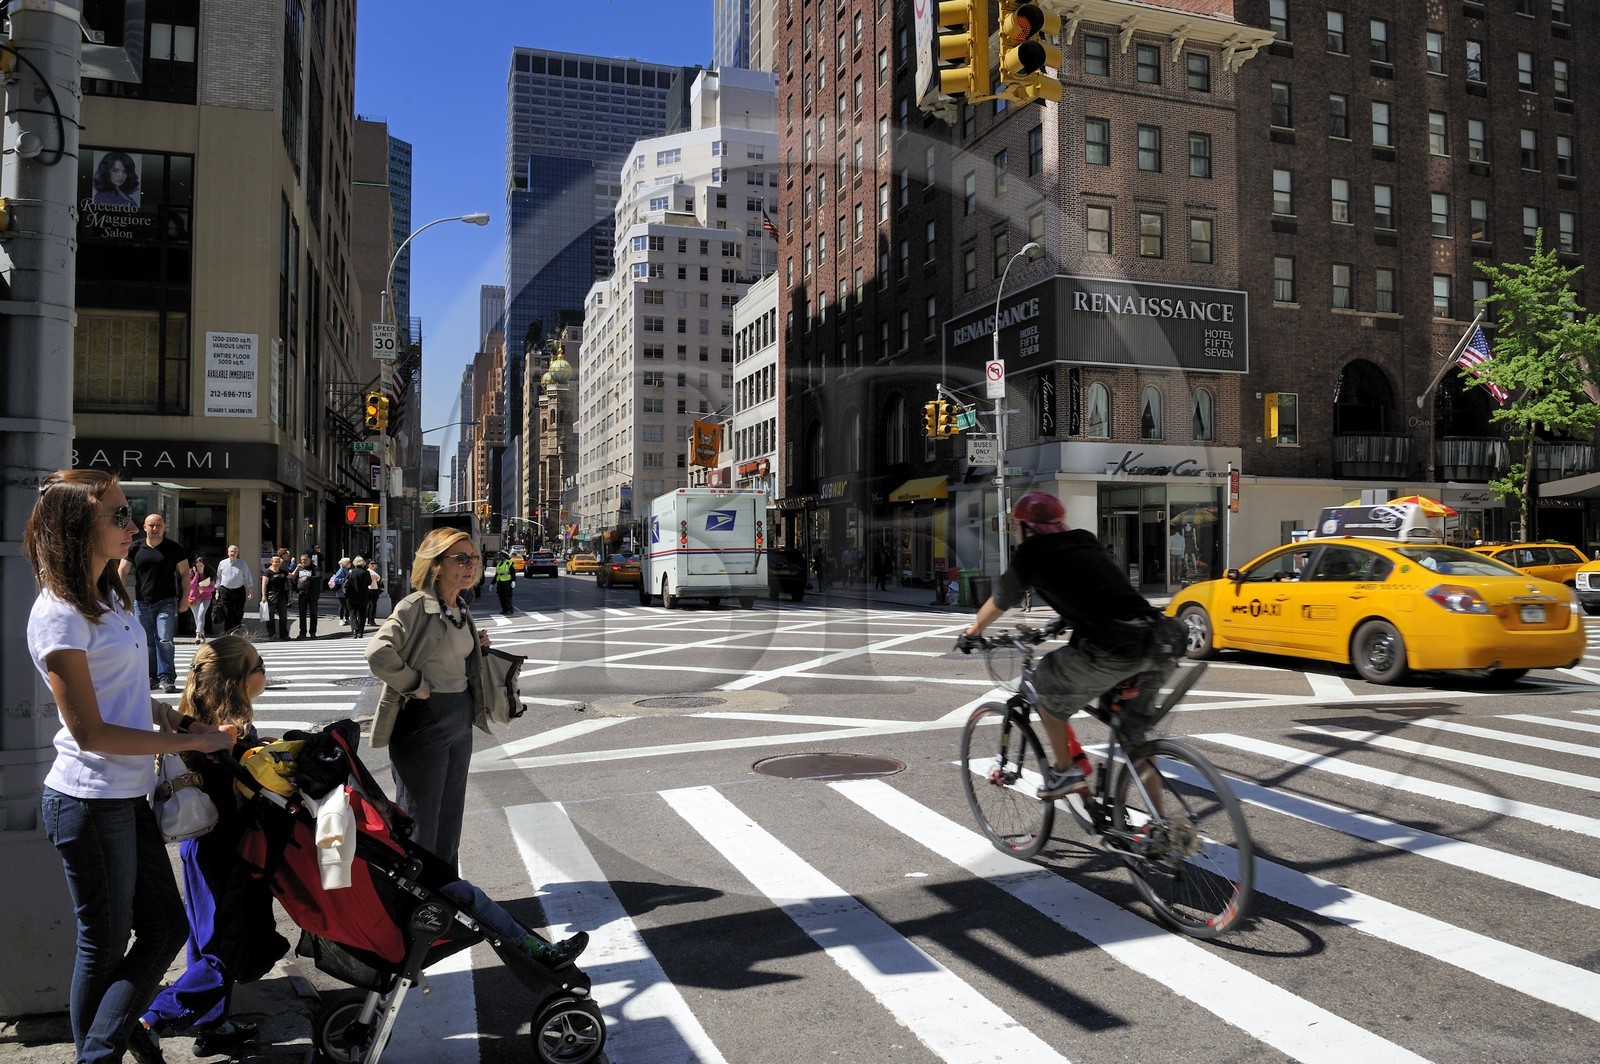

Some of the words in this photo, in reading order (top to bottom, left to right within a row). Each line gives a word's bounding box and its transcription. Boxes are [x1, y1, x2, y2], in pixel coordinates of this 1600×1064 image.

[80, 197, 139, 214] Riccardo
[85, 212, 152, 228] Maggiore
[101, 227, 133, 238] Salon
[1072, 291, 1234, 323] RENAISSANCE
[1019, 325, 1039, 338] HOTEL
[1204, 329, 1234, 340] HOTEL
[374, 338, 394, 350] 30
[1020, 334, 1039, 348] FIFTY
[1205, 339, 1234, 348] FIFTY
[1020, 344, 1039, 357] SEVEN
[1204, 348, 1234, 358] SEVEN
[207, 370, 228, 379] AVAILABLE
[229, 370, 254, 380] IMMEDIATELY
[820, 480, 848, 499] SUBWAY
